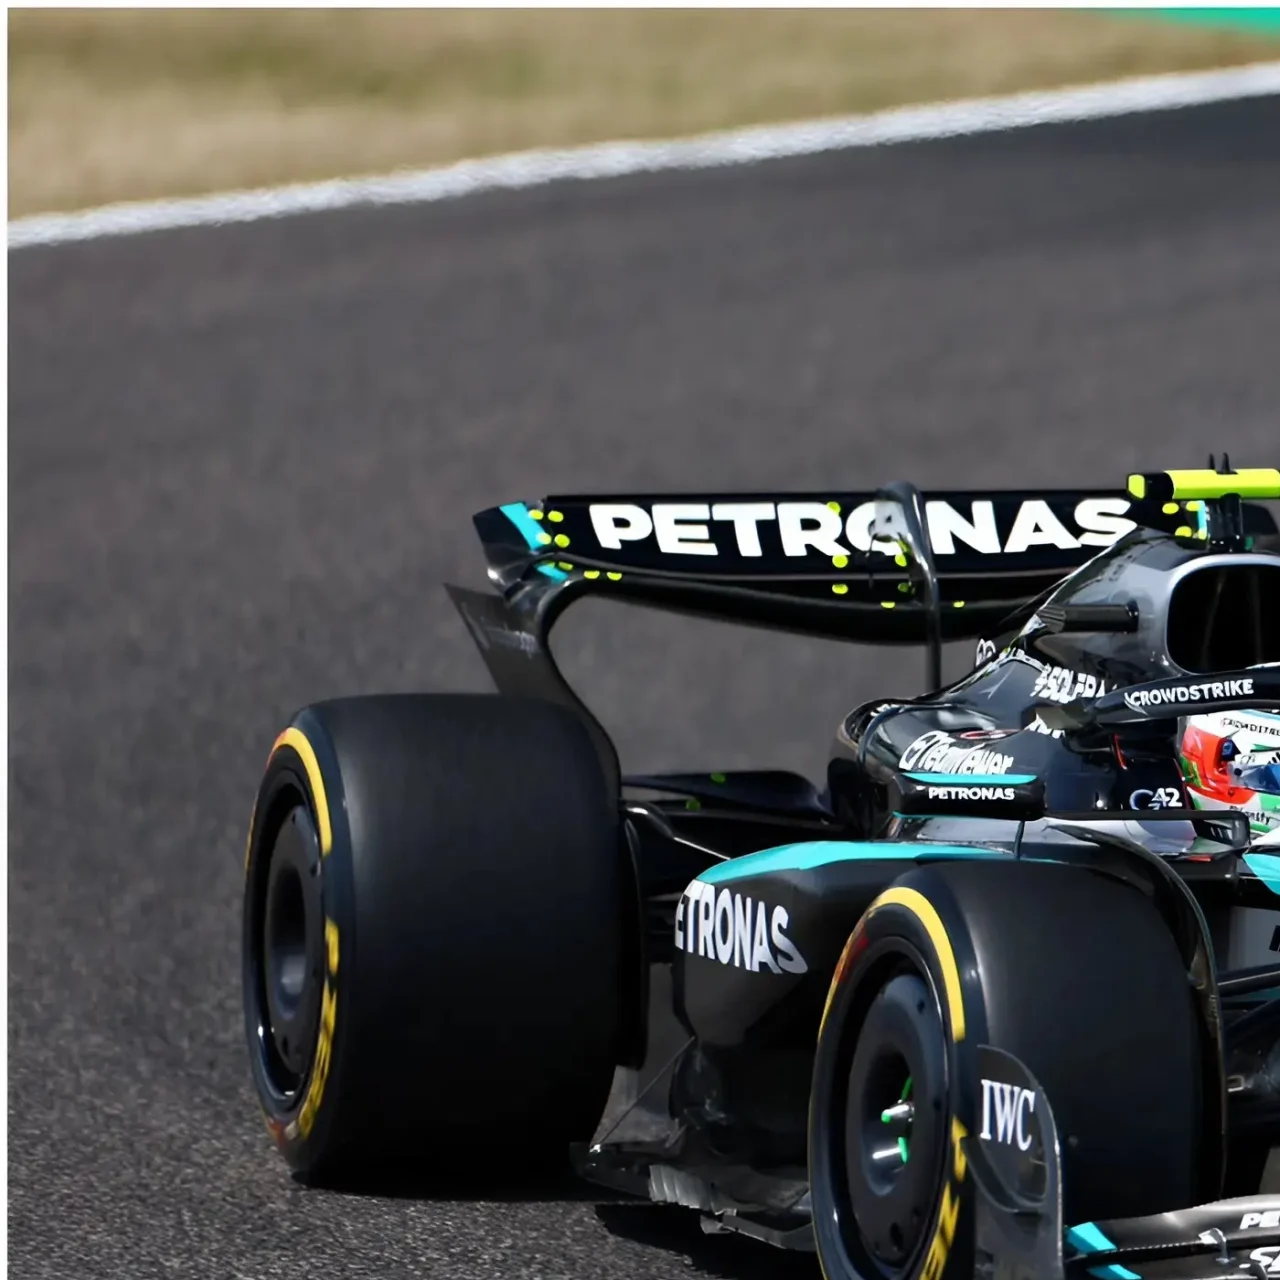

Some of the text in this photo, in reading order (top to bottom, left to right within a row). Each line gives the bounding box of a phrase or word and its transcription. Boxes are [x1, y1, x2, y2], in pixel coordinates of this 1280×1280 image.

[589, 498, 1137, 557] PETRONAS
[1130, 679, 1254, 706] CROWDSTRIKE
[928, 787, 1015, 800] PETRONAS
[980, 1079, 1036, 1151] IWC
